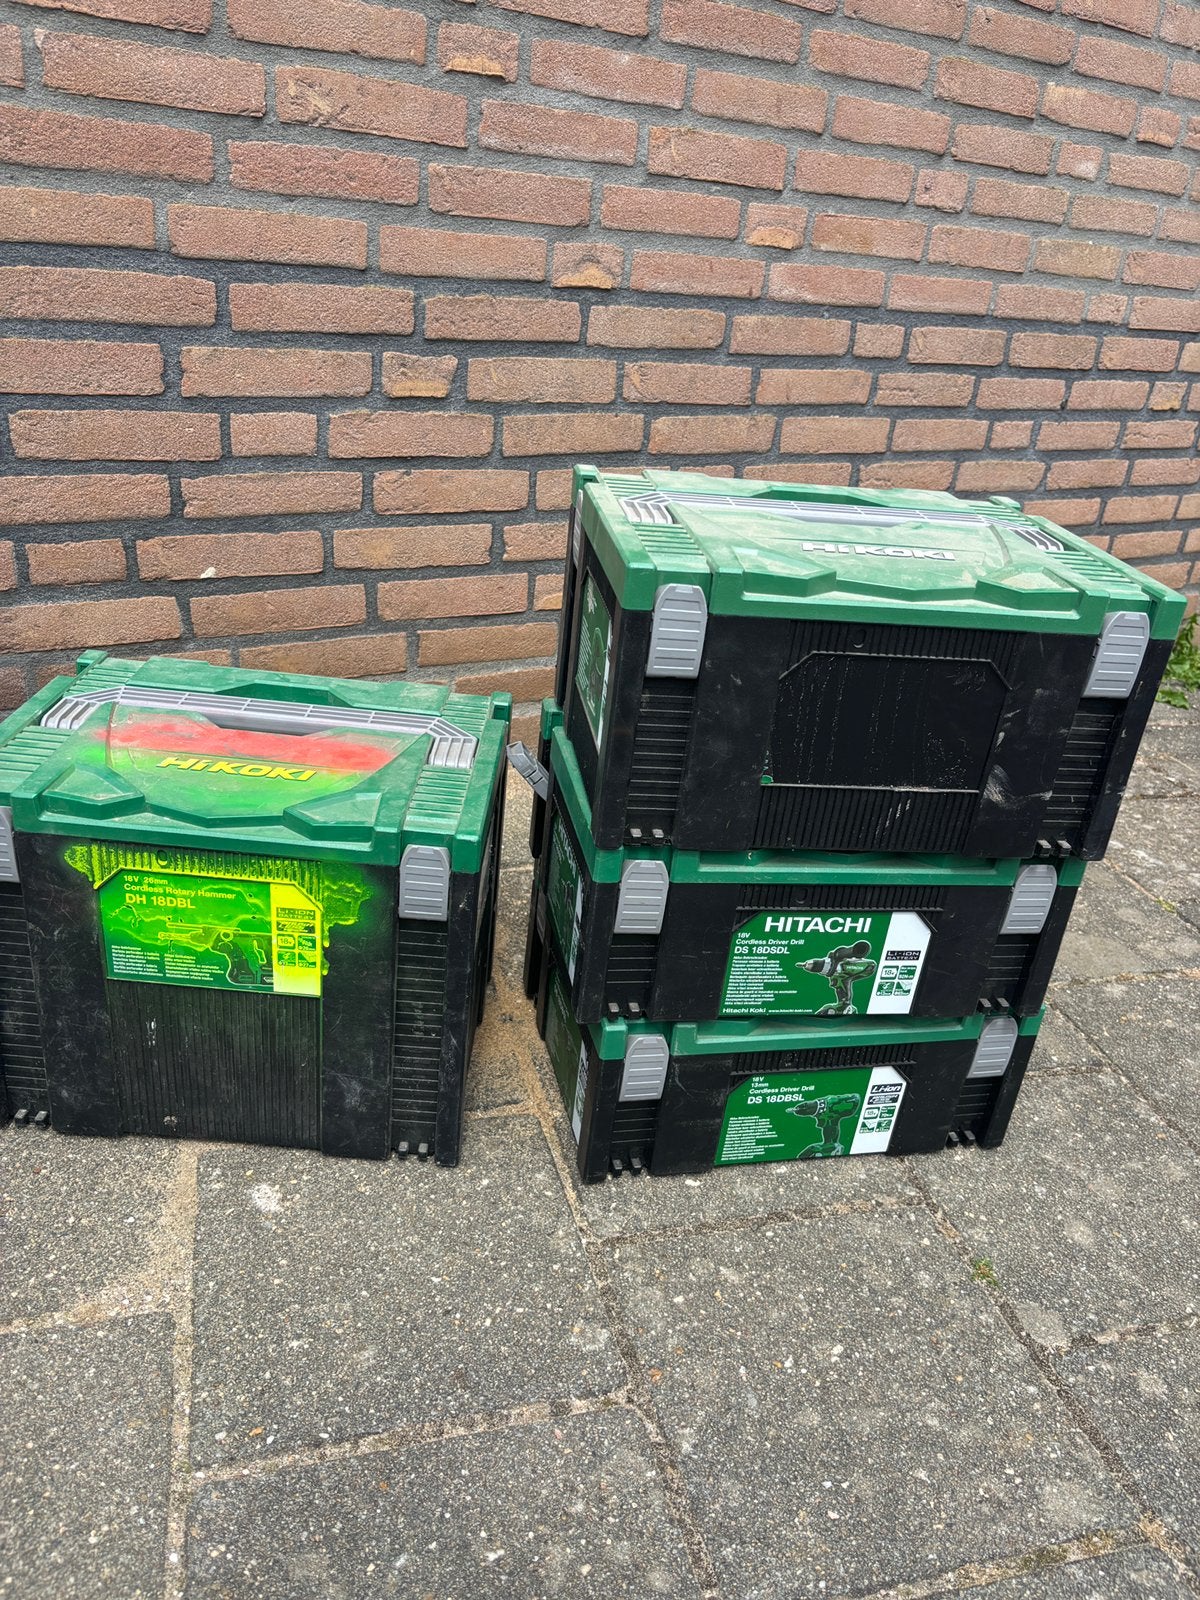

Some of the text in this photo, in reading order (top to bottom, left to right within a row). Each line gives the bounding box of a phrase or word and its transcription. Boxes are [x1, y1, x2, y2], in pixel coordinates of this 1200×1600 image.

[158, 757, 317, 781] HiKOKI
[123, 875, 168, 885] 18V 26mm
[123, 883, 237, 899] Cordless Rotary Hammer
[125, 893, 196, 909] DH 18DBL
[764, 916, 872, 933] HITACHI
[734, 946, 790, 954] DS 18DSDL
[747, 1093, 805, 1104] DS 18DBSL
